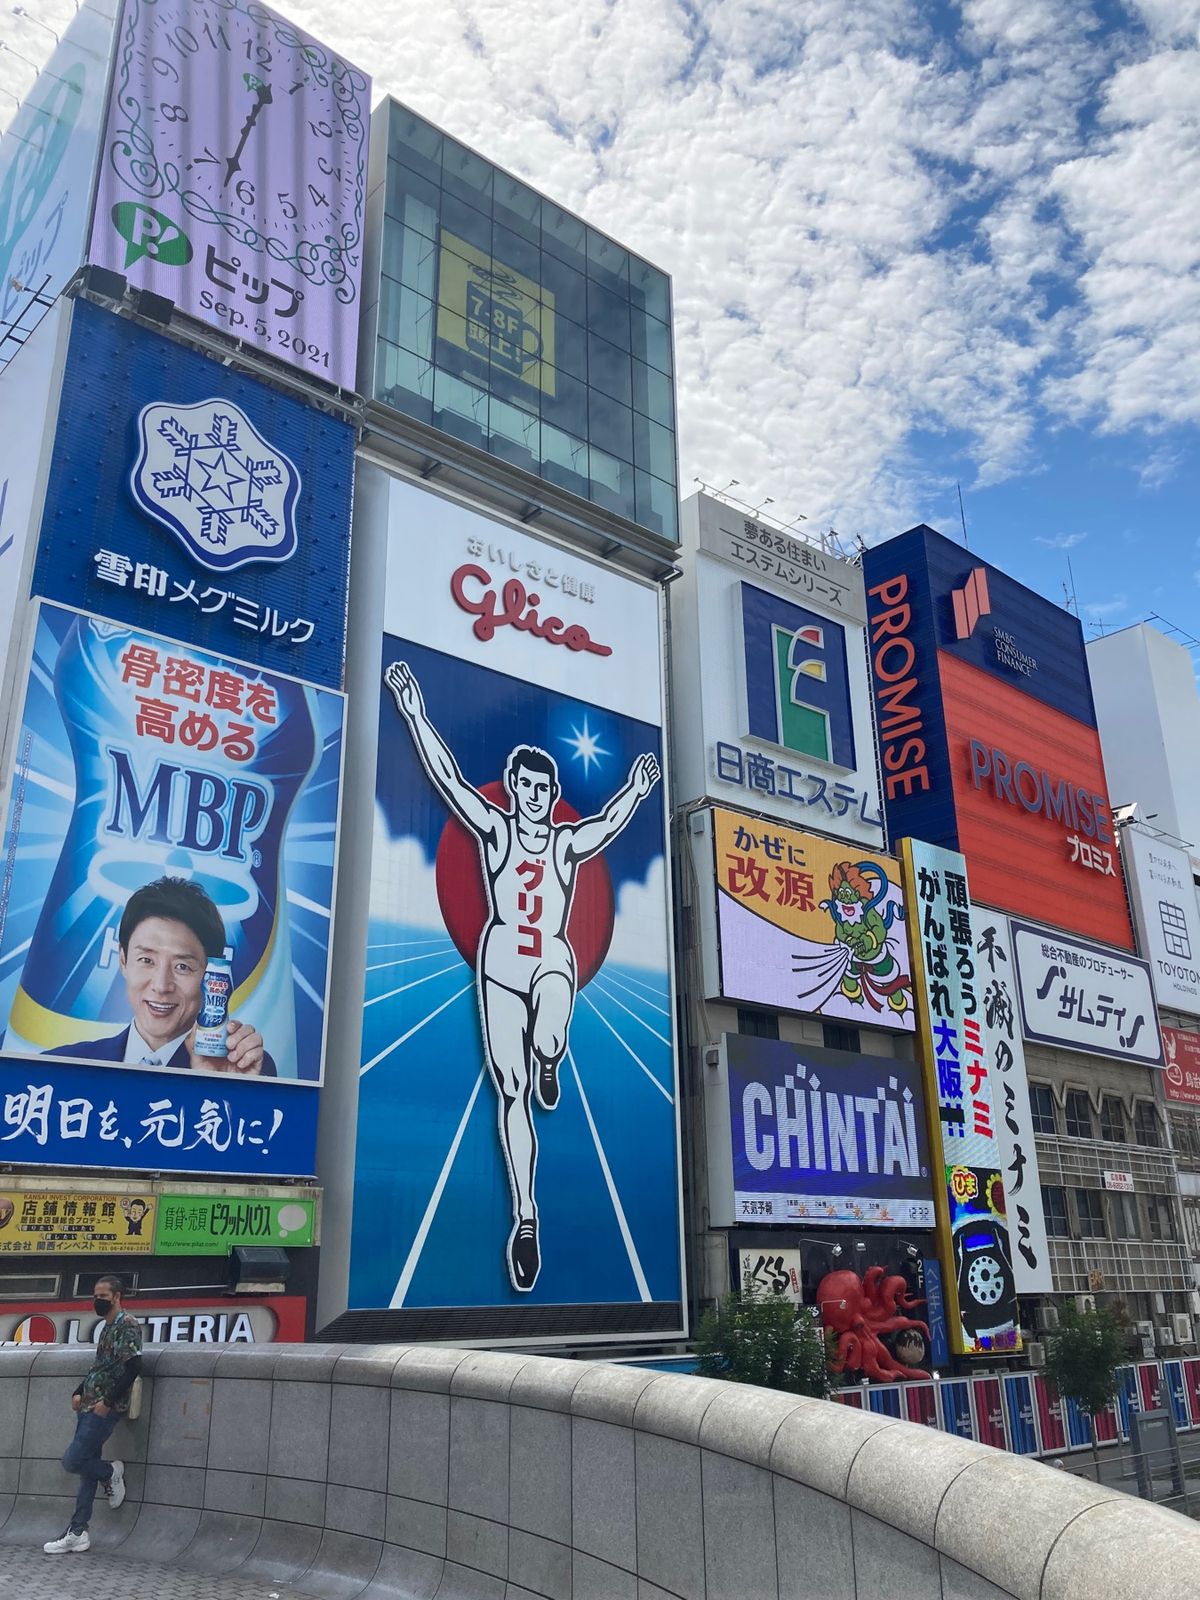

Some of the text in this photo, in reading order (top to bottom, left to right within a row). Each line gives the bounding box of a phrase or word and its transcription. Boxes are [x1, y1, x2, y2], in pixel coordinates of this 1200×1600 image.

[165, 26, 199, 58] 10
[202, 22, 231, 52] 11
[151, 56, 180, 83] 9
[242, 39, 273, 72] 12
[160, 102, 189, 123] 8
[308, 120, 333, 138] 2
[193, 147, 221, 165] 7
[317, 157, 341, 182] 3
[235, 180, 256, 206] 6
[277, 192, 298, 219] 5
[307, 183, 330, 207] 4
[204, 244, 304, 318] ピップ
[199, 290, 330, 368] Sep. 5, 2021
[744, 520, 826, 571] 夢ある住まい
[467, 535, 595, 604] おいしさと健康
[731, 541, 842, 606] エステムシリーズ
[94, 549, 315, 643] 雪印メグミルク
[451, 563, 613, 657] Glico
[993, 626, 1016, 646] SMBC
[995, 638, 1039, 670] CONSUMER
[997, 650, 1032, 677] FINANCE
[121, 643, 278, 724] 骨密度を
[868, 573, 930, 800] PROMISE
[135, 695, 256, 761] 高める
[716, 740, 884, 829] 日商エステム
[969, 738, 1112, 844] PROMISE
[106, 748, 267, 860] MBP
[733, 825, 806, 867] かぜに
[1066, 834, 1117, 878] プロミス
[726, 853, 817, 913] 改源
[515, 858, 546, 958] グリコ
[1041, 943, 1134, 980] 総合不動産のプロデューサー
[206, 995, 228, 1008] MBP
[1057, 984, 1126, 1032] サムティ
[22, 1200, 116, 1216] 店舗情報館
[165, 1206, 208, 1232] 賃貸・売買
[210, 1203, 271, 1236] ピタットハウス
[742, 1200, 773, 1215] 天気予報
[36, 1241, 95, 1251] 関西インベスト
[68, 1313, 255, 1343] LTERIA
